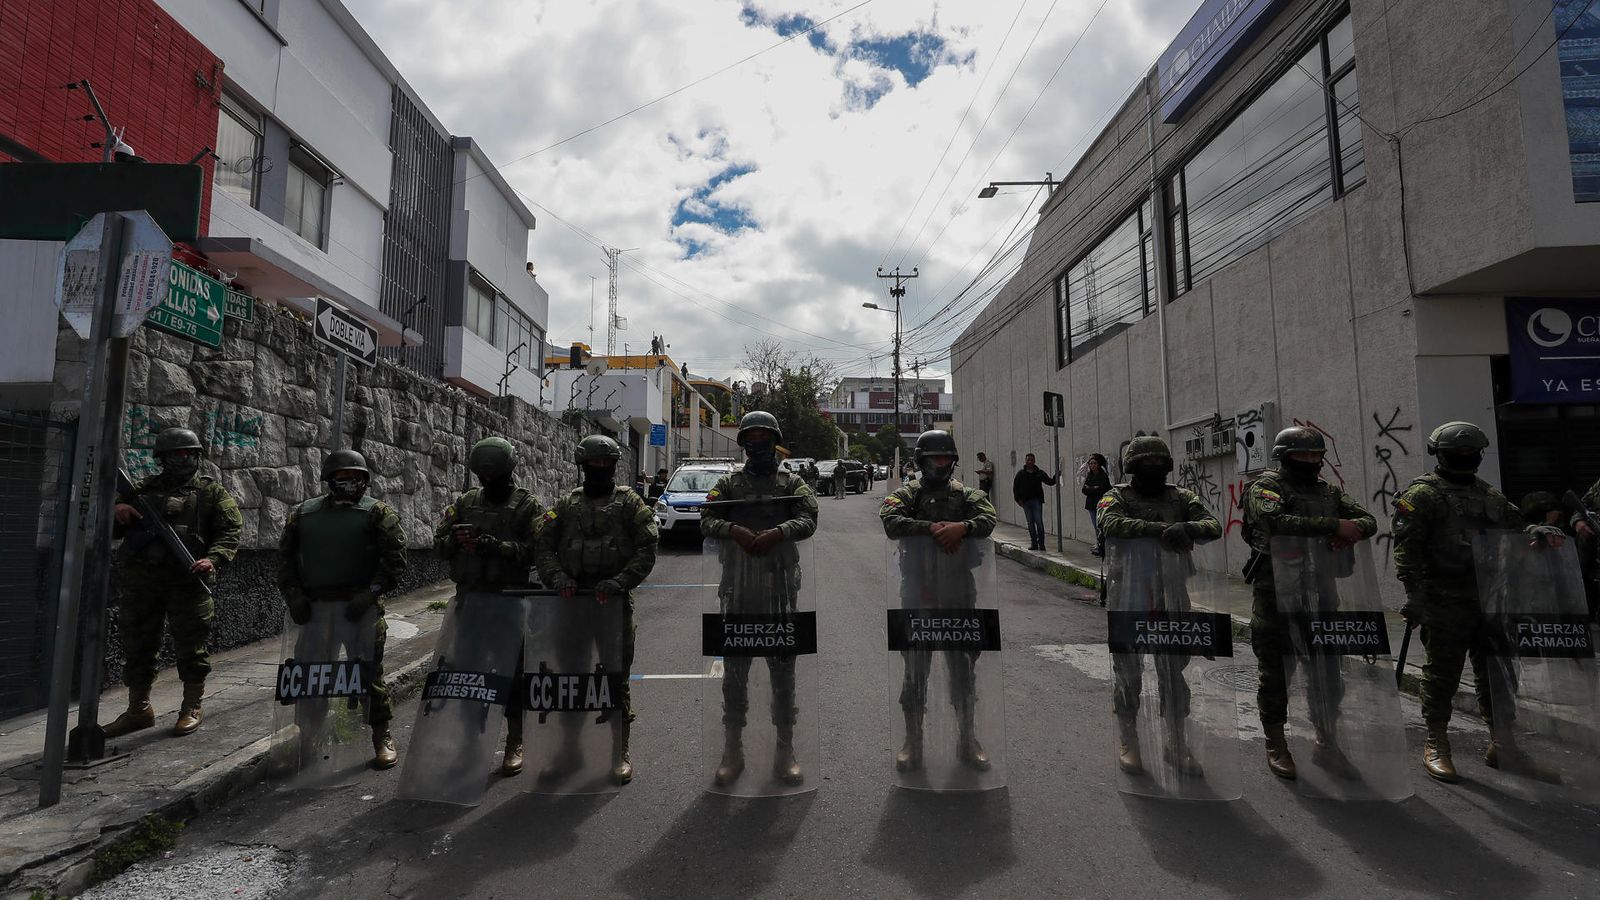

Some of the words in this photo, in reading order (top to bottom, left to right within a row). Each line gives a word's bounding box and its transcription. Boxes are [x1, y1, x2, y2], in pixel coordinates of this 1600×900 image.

[170, 316, 197, 335] E9-75
[330, 316, 353, 343] DOBLE
[355, 330, 365, 349] VIA
[1542, 379, 1569, 392] YA
[724, 623, 795, 634] FUERZAS
[911, 618, 980, 629] FUERZAS
[1135, 620, 1211, 633] FUERZAS
[1311, 621, 1377, 632] FUERZAS
[1517, 623, 1585, 634] FUERZAS
[724, 635, 795, 647] ARMADAS
[911, 630, 981, 642] ARMADAS
[1135, 634, 1212, 646] ARMADAS
[1312, 634, 1380, 645] ARMADAS
[1519, 636, 1587, 648] ARMADAS
[280, 664, 367, 697] CC.FF.AA.
[437, 672, 485, 687] FUERZA
[427, 685, 497, 701] TERRESTRE
